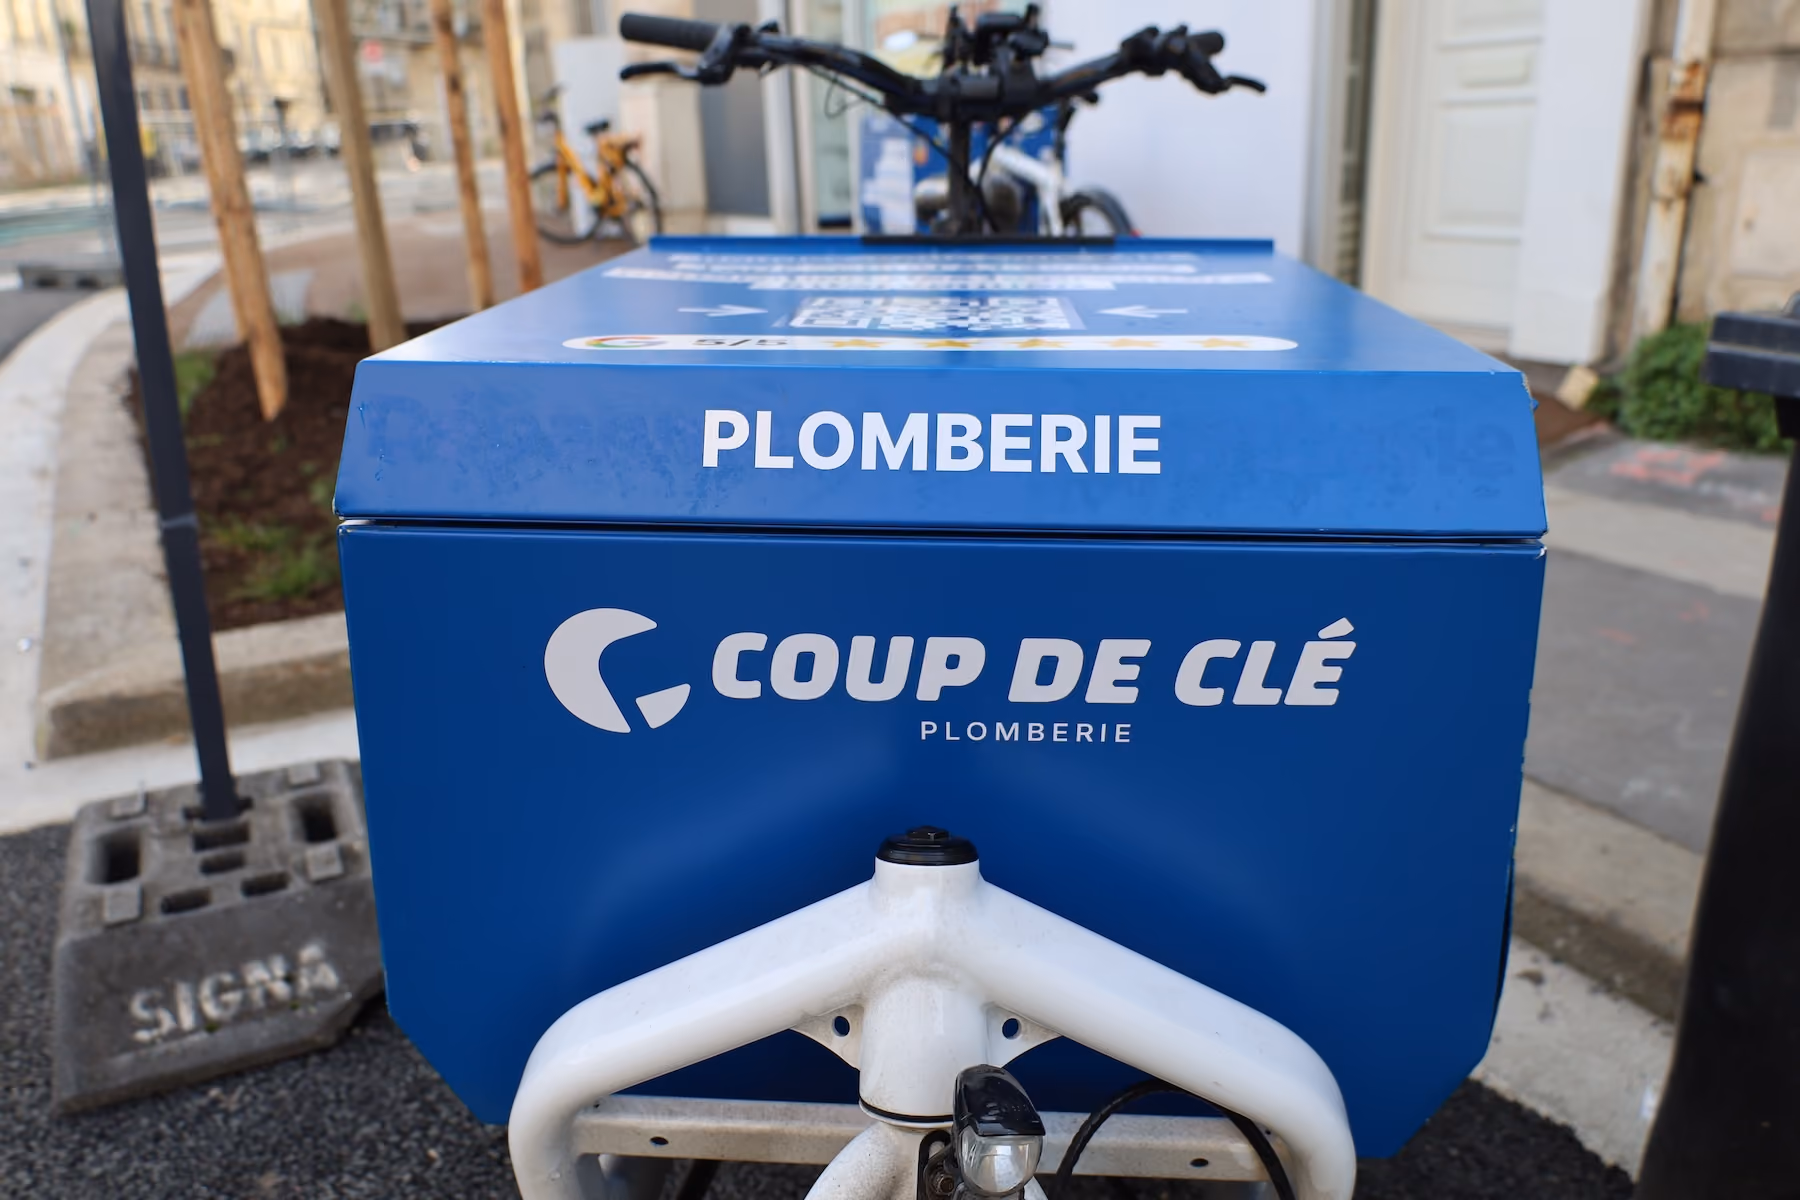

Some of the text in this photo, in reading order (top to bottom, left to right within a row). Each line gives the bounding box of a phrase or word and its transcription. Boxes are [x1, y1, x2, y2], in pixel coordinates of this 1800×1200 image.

[693, 338, 787, 347] 5/5
[702, 409, 1163, 474] PLOMBERIE
[712, 616, 1357, 707] COUP DE CLÉ
[920, 721, 1132, 742] PLOMBERIE
